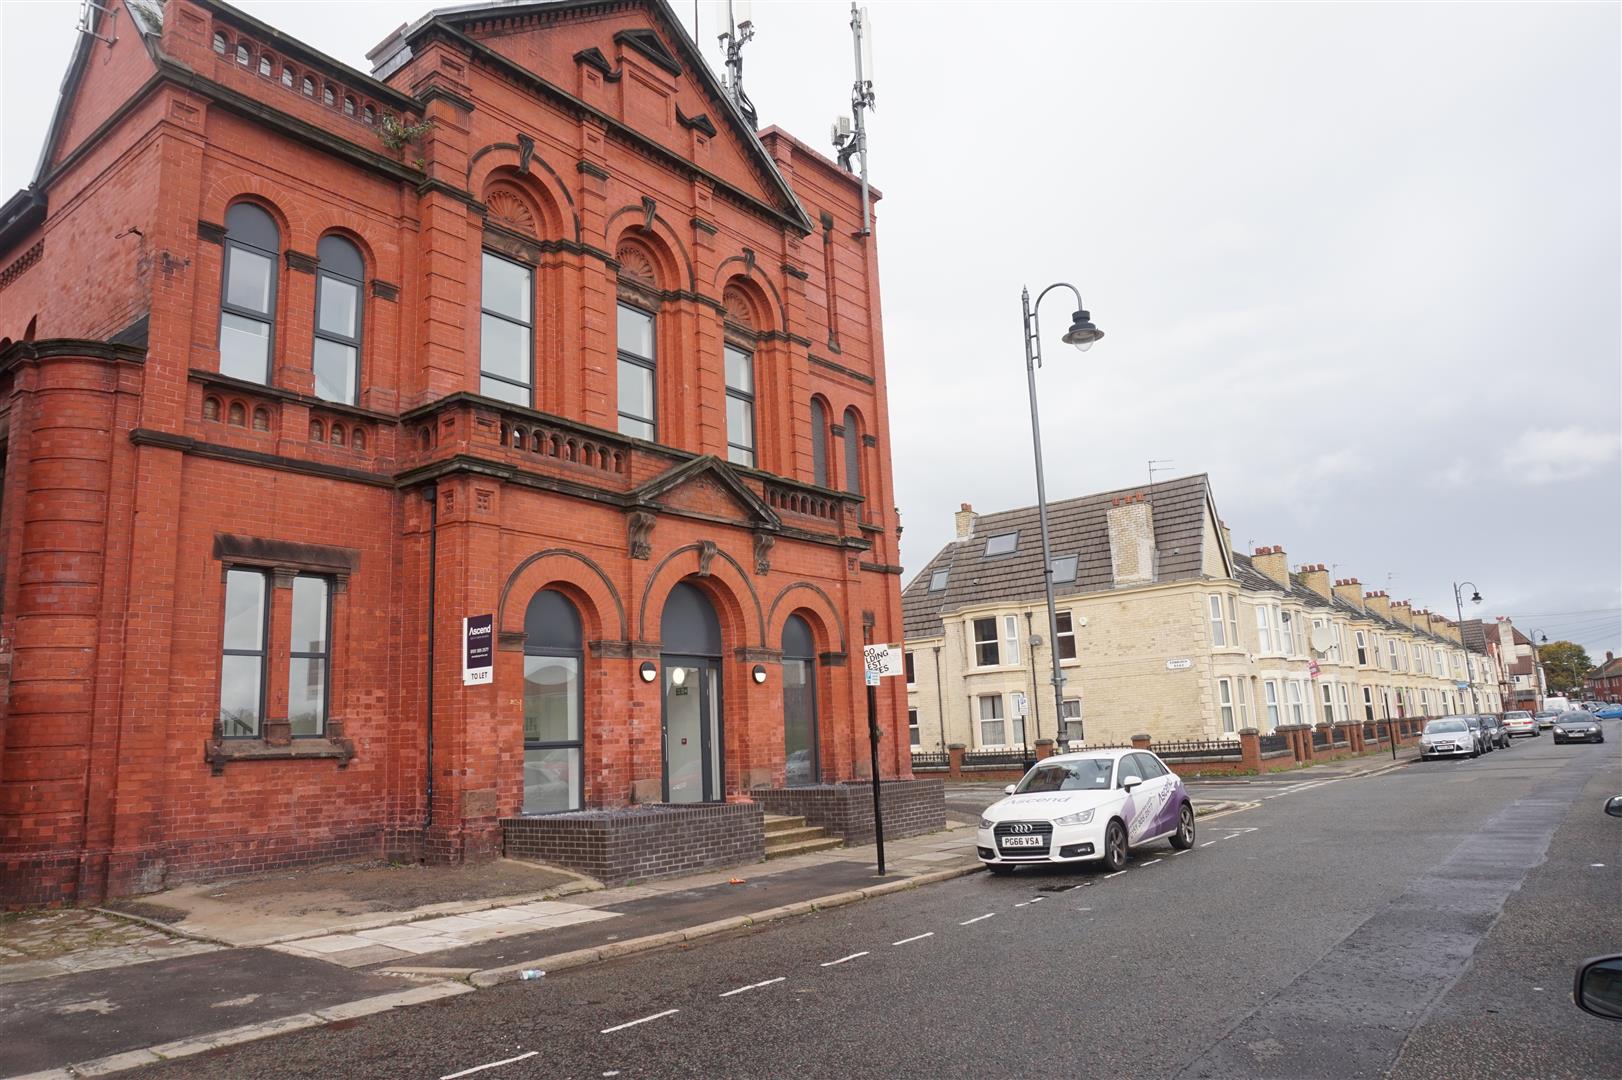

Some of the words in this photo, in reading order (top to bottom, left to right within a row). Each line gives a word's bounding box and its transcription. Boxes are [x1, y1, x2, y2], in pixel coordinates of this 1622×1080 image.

[469, 624, 491, 636] Ascend
[864, 647, 875, 657] GO
[866, 649, 889, 663] LDING
[867, 659, 882, 670] EST
[479, 671, 487, 679] LET
[1004, 796, 1071, 806] Ascend
[1004, 837, 1024, 846] PG66
[1024, 837, 1040, 845] VSA
